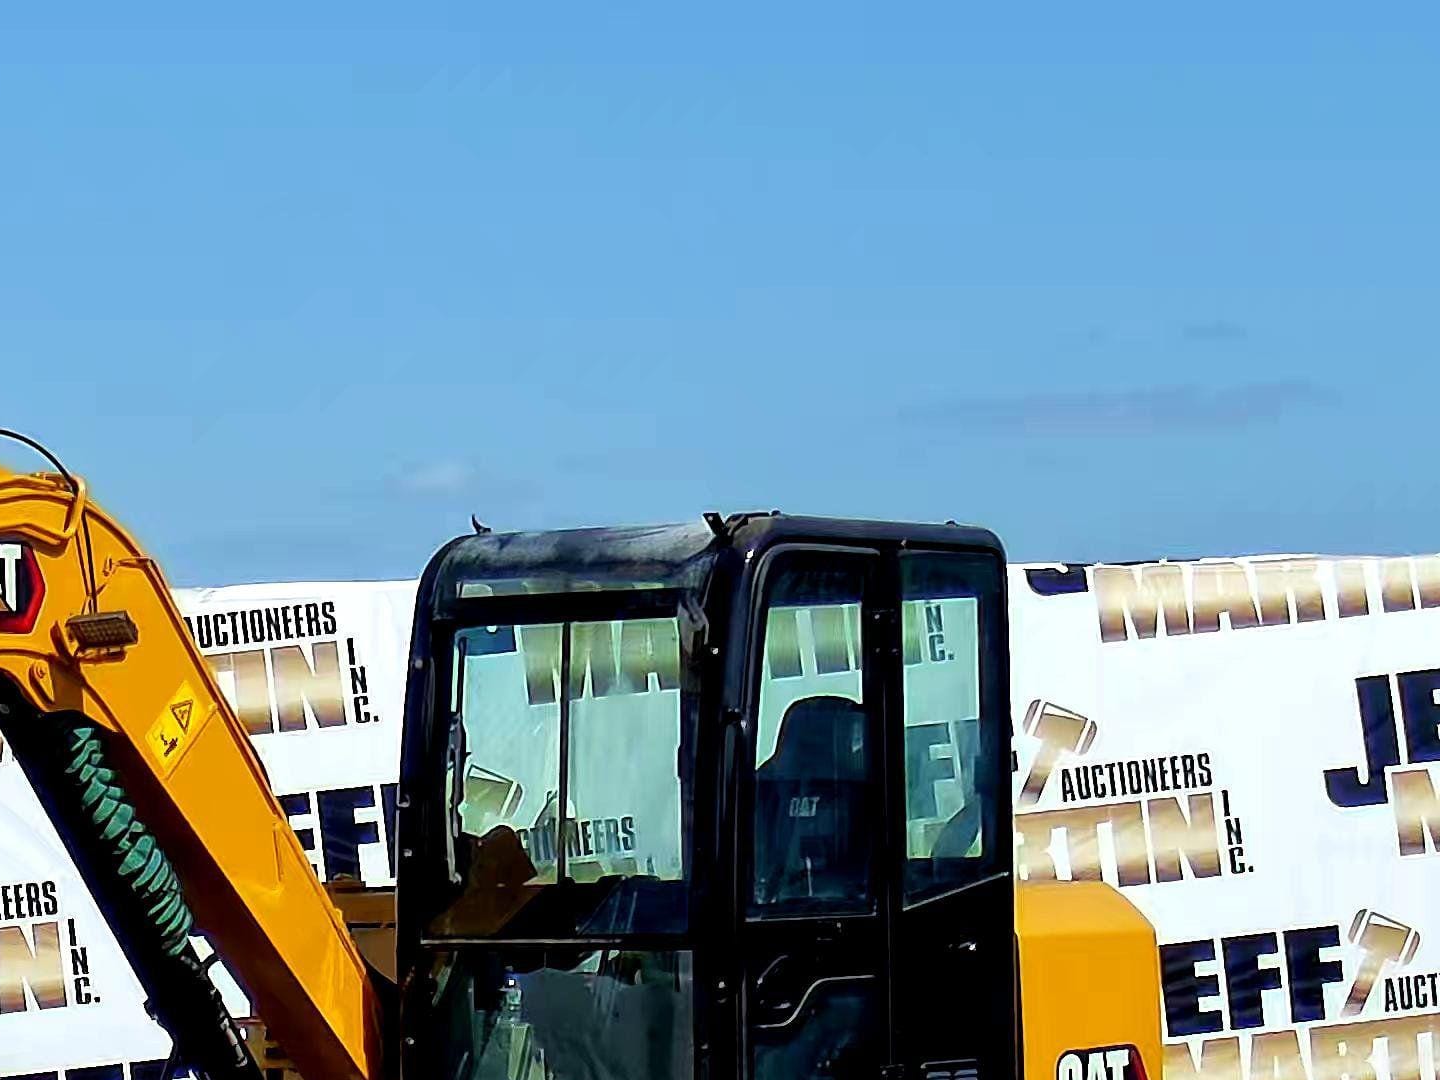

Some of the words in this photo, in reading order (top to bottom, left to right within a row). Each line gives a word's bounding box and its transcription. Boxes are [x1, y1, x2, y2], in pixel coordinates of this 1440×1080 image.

[1061, 753, 1213, 802] AUCTIONEERS
[1323, 668, 1440, 808] JE
[1015, 792, 1222, 887] RTIN
[1159, 925, 1343, 1037] EFF
